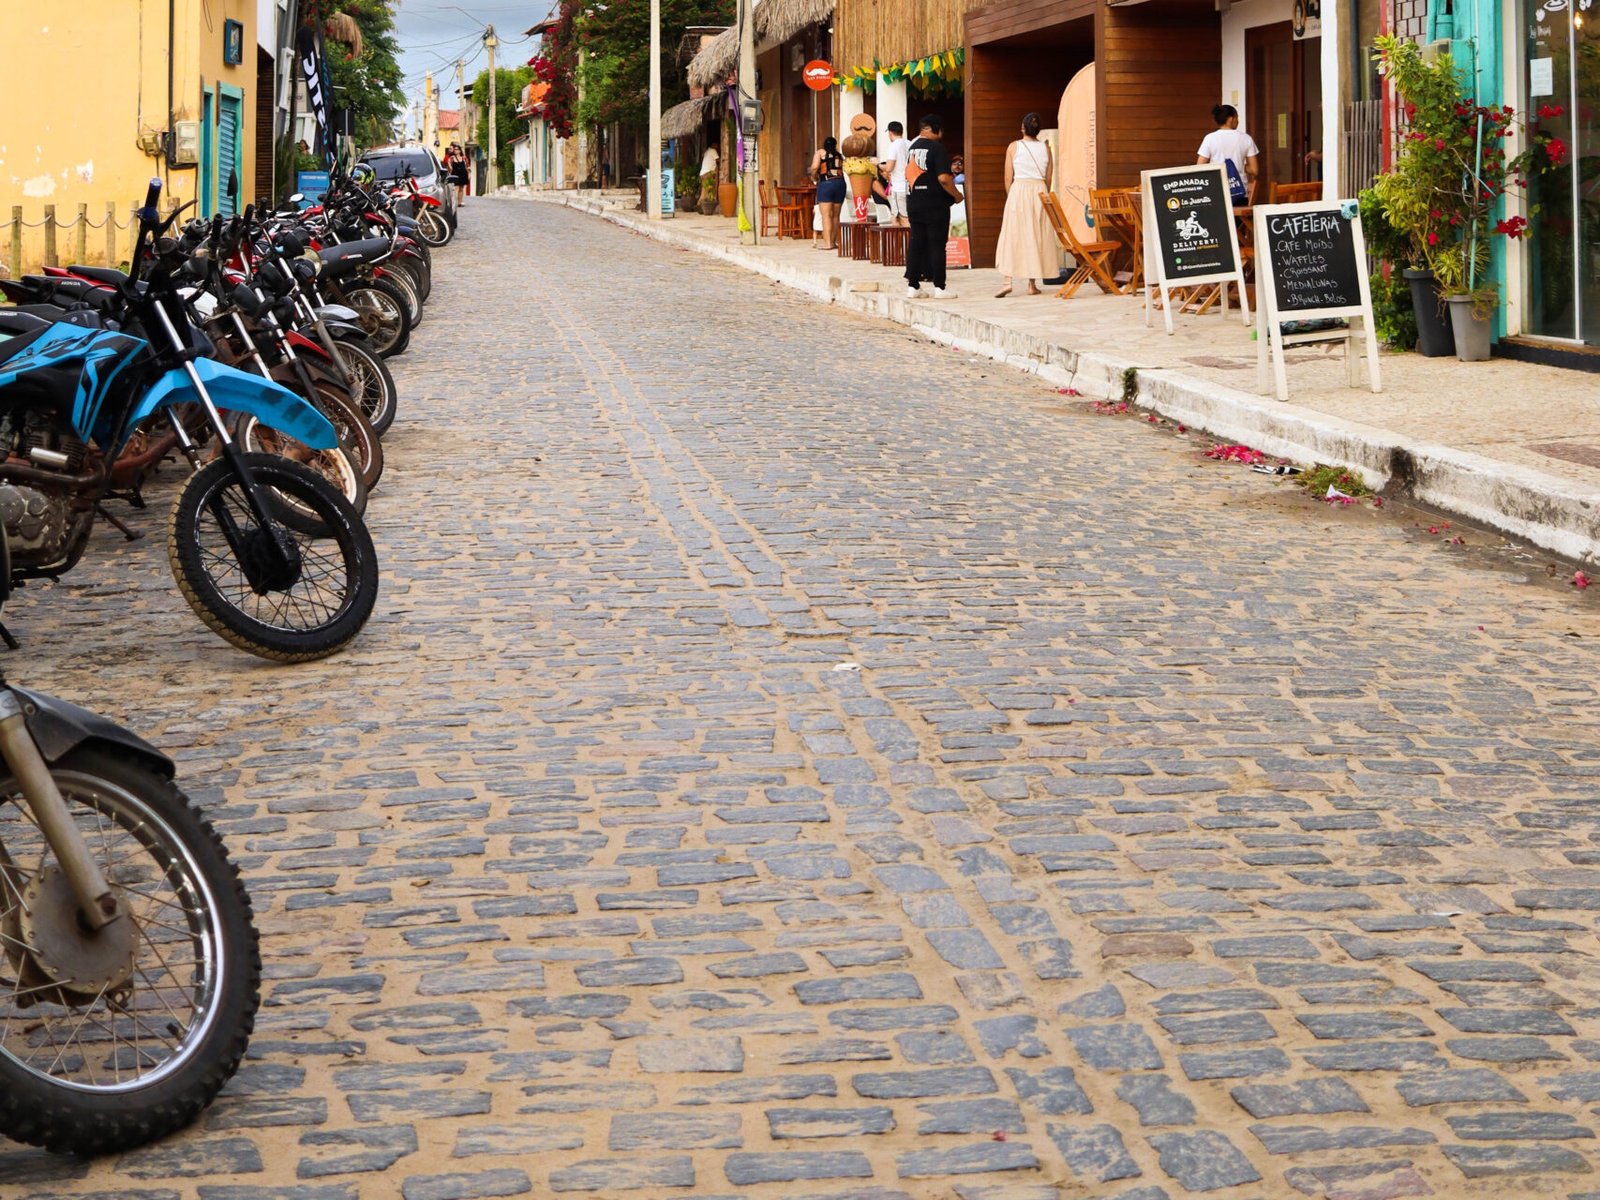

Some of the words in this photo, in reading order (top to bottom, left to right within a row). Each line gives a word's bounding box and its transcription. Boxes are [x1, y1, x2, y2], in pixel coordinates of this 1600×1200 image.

[1163, 179, 1209, 191] EMPANADAS
[1173, 238, 1218, 248] DELIVERY!
[1277, 240, 1300, 253] CAFE
[1282, 253, 1325, 267] WAFFLES
[1284, 264, 1328, 279] CROISSANT
